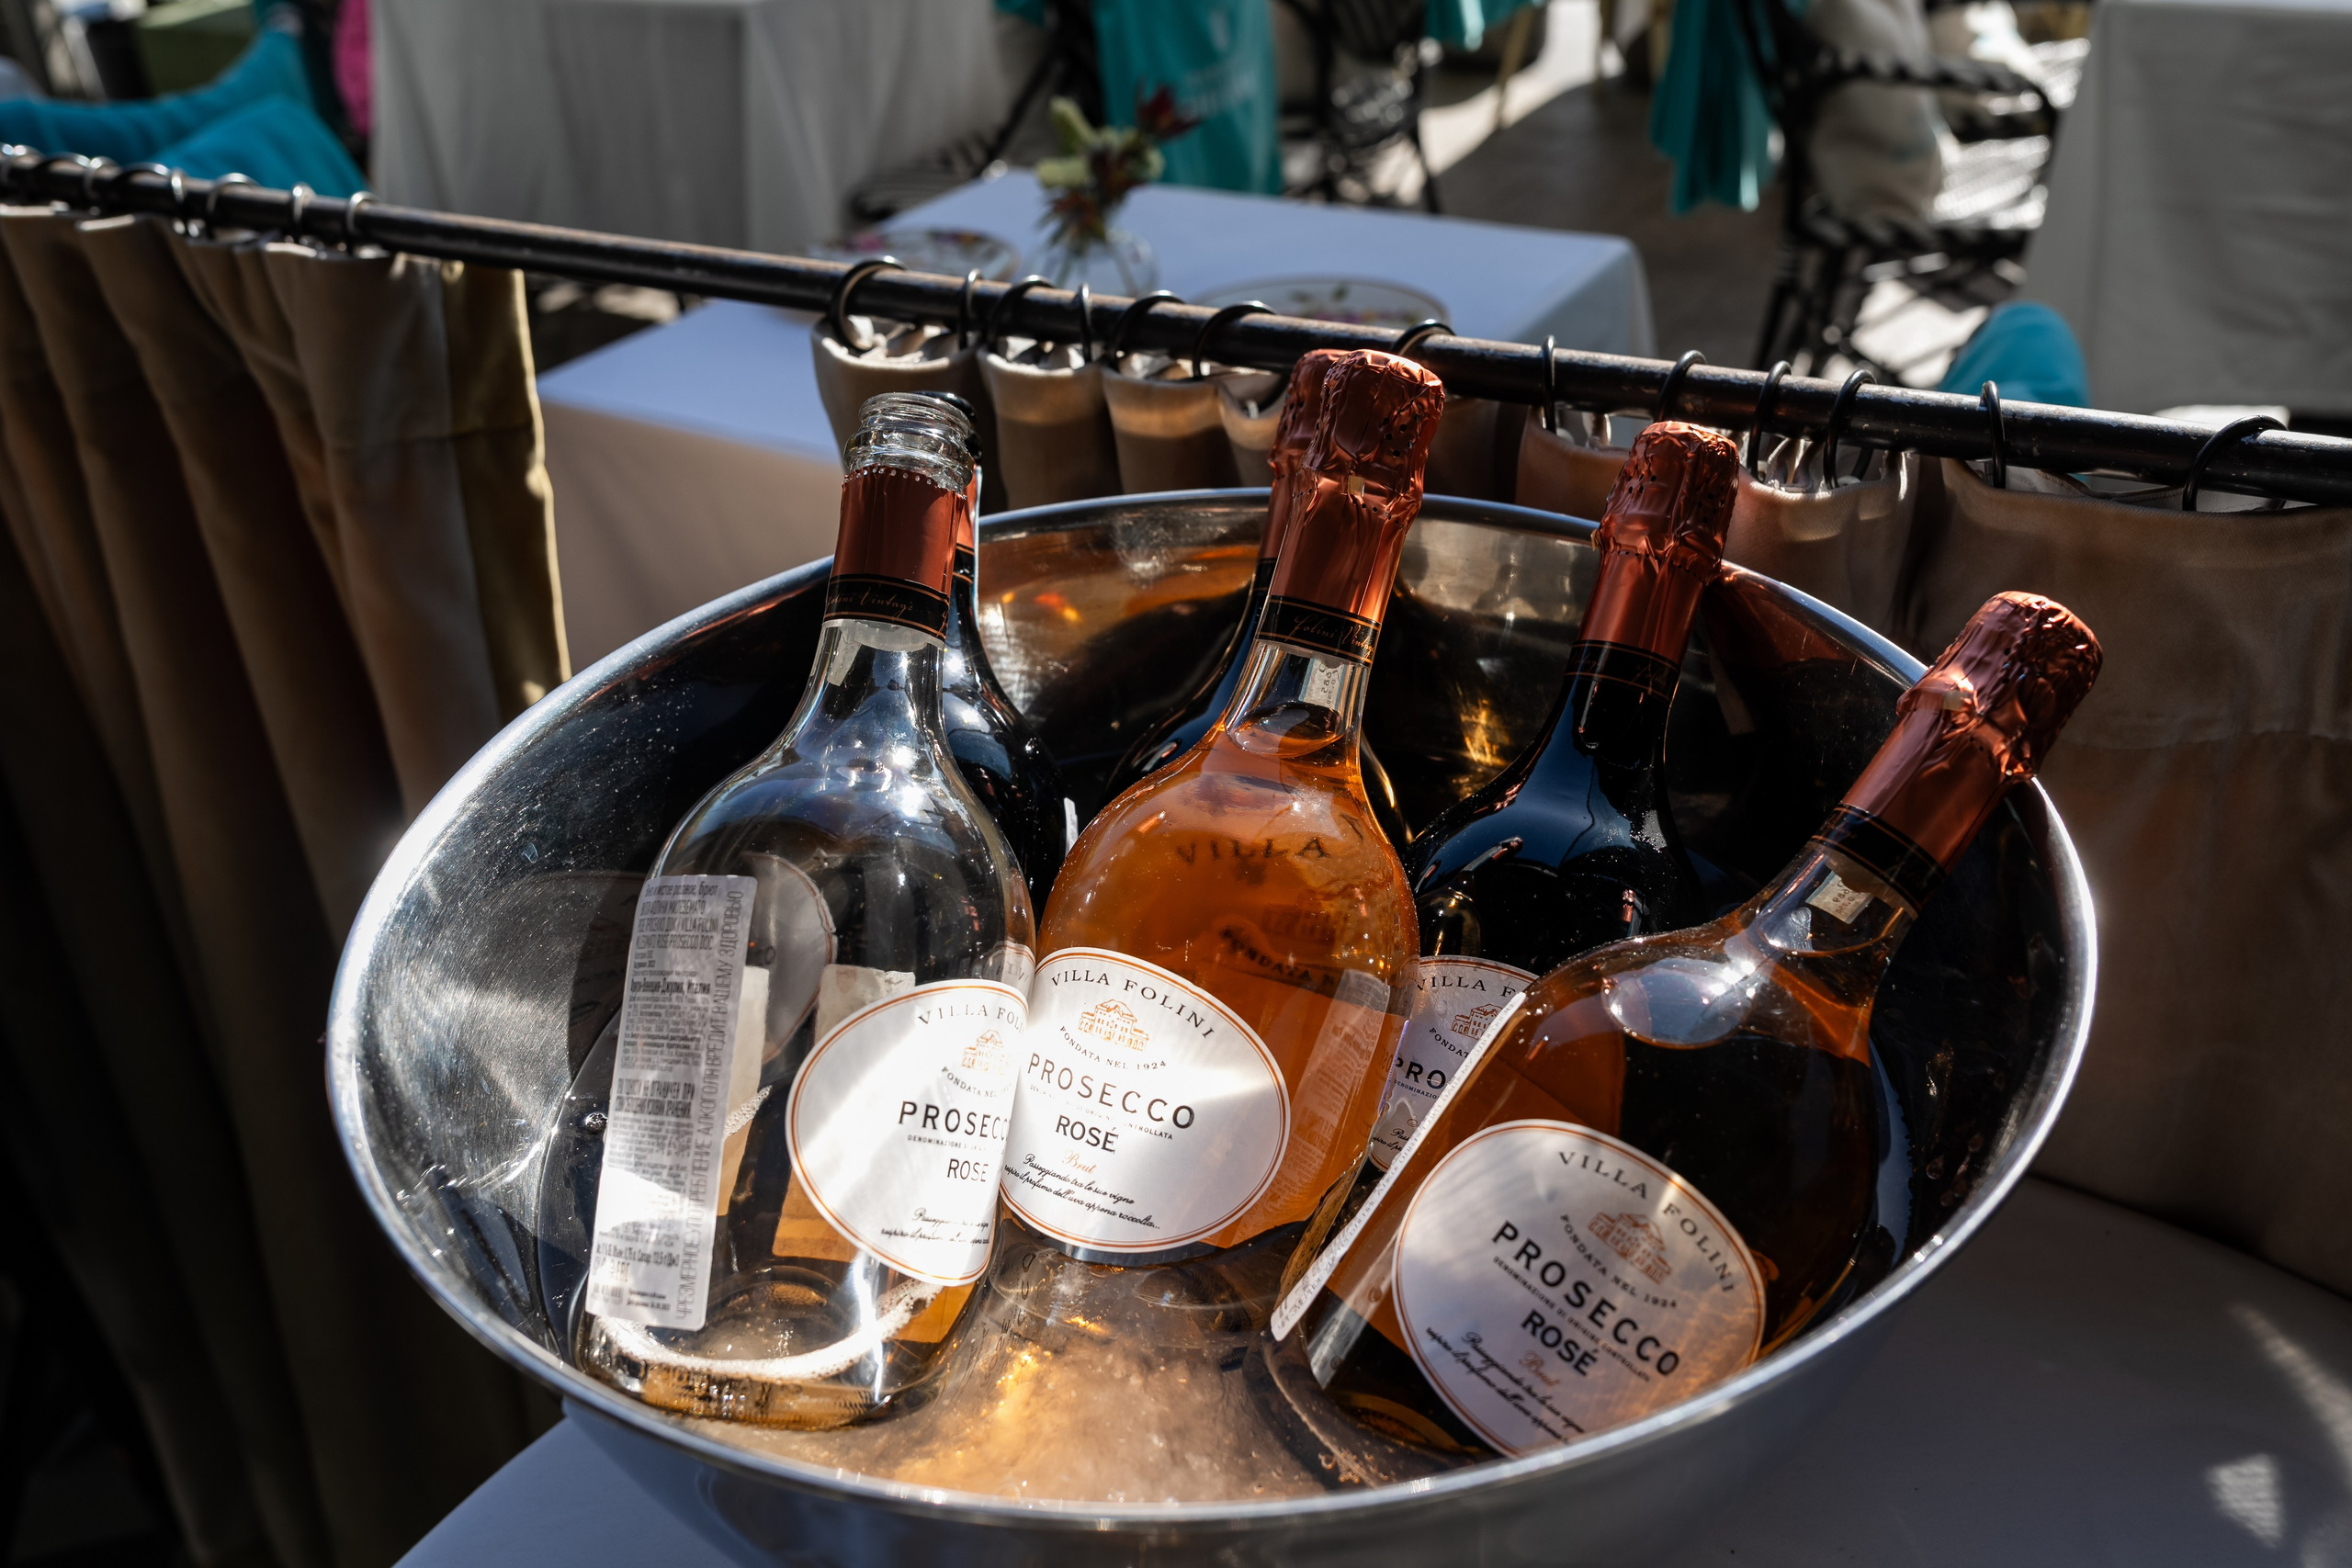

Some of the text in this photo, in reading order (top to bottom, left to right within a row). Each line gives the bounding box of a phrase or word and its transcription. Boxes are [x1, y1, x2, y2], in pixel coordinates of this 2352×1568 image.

[1051, 969, 1110, 987] VILLA
[1123, 979, 1215, 1039] FOLINI
[1417, 976, 1487, 993] VILLA
[917, 1004, 989, 1024] VILLA
[1059, 1025, 1167, 1070] FONDATA NEL 1924
[1429, 1027, 1470, 1058] FONDAT
[942, 1066, 982, 1096] FONDATA
[1027, 1052, 1195, 1129] PROSECCO
[1394, 1078, 1439, 1100] DENOMINAZIO
[675, 891, 744, 1320] ЧРЕЗМЕРНОЕ УПОТРЕБЛЕНИЕ АЛКОГОЛЯ ВРЕДИТ ВАШЕМУ ЗДОРОВЬЮ
[898, 1100, 1010, 1142] PROSECC
[1056, 1114, 1119, 1154] ROSÉ
[1023, 1153, 1070, 1183] Passeggiando
[1071, 1178, 1084, 1188] tra
[1092, 1187, 1108, 1197] sue
[1109, 1191, 1135, 1205] vigne
[1062, 1149, 1097, 1174] Brut
[1023, 1174, 1053, 1192] profumo
[1053, 1187, 1084, 1205] dell'uva
[1085, 1201, 1117, 1217] appena
[1559, 1151, 1735, 1292] VILLA FOLINI
[1560, 1213, 1607, 1276] FONDATA
[1611, 1275, 1637, 1297] NEL
[1492, 1219, 1679, 1376] PROSECCO
[1493, 1255, 1556, 1310] DENOMINAZIONE
[1521, 1309, 1600, 1377] ROSÉ
[1519, 1349, 1560, 1388] Brut
